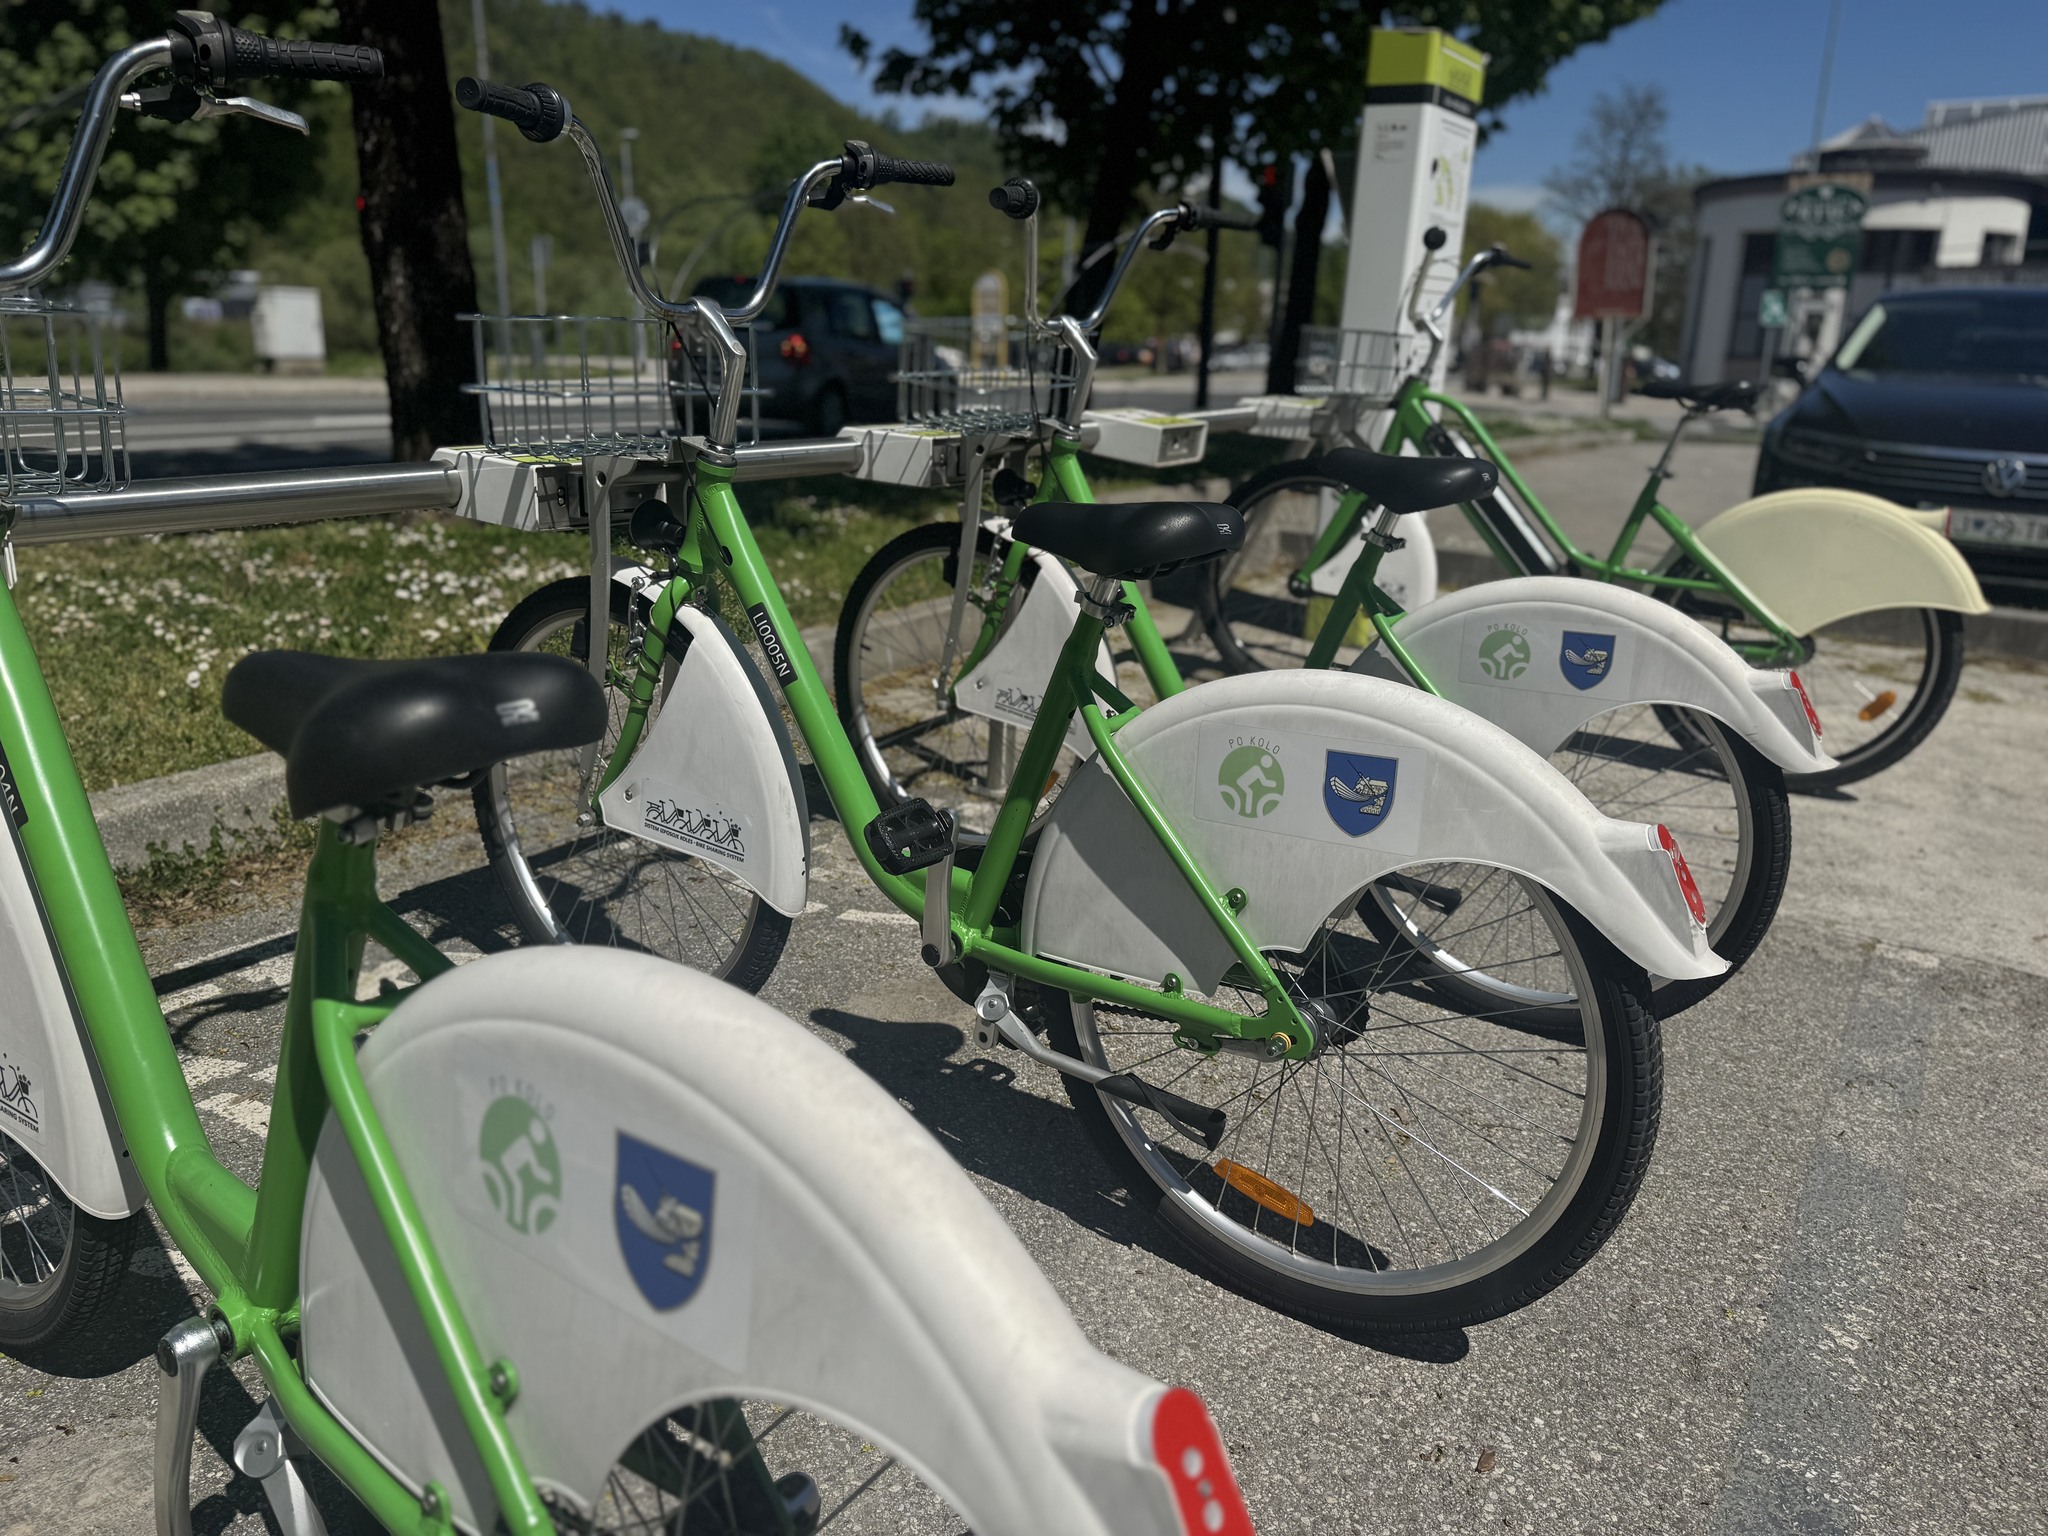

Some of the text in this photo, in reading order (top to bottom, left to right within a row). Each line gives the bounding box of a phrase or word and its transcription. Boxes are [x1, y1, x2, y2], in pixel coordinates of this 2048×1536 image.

[752, 611, 791, 677] LI0005N
[1228, 736, 1281, 755] PO KOLO
[644, 822, 660, 832] SISTEM
[680, 835, 694, 845] KOLES
[695, 841, 706, 850] BIKE
[706, 845, 727, 857] SHARING
[726, 852, 745, 863] SYSTEM
[18, 1116, 39, 1134] SYSTEM
